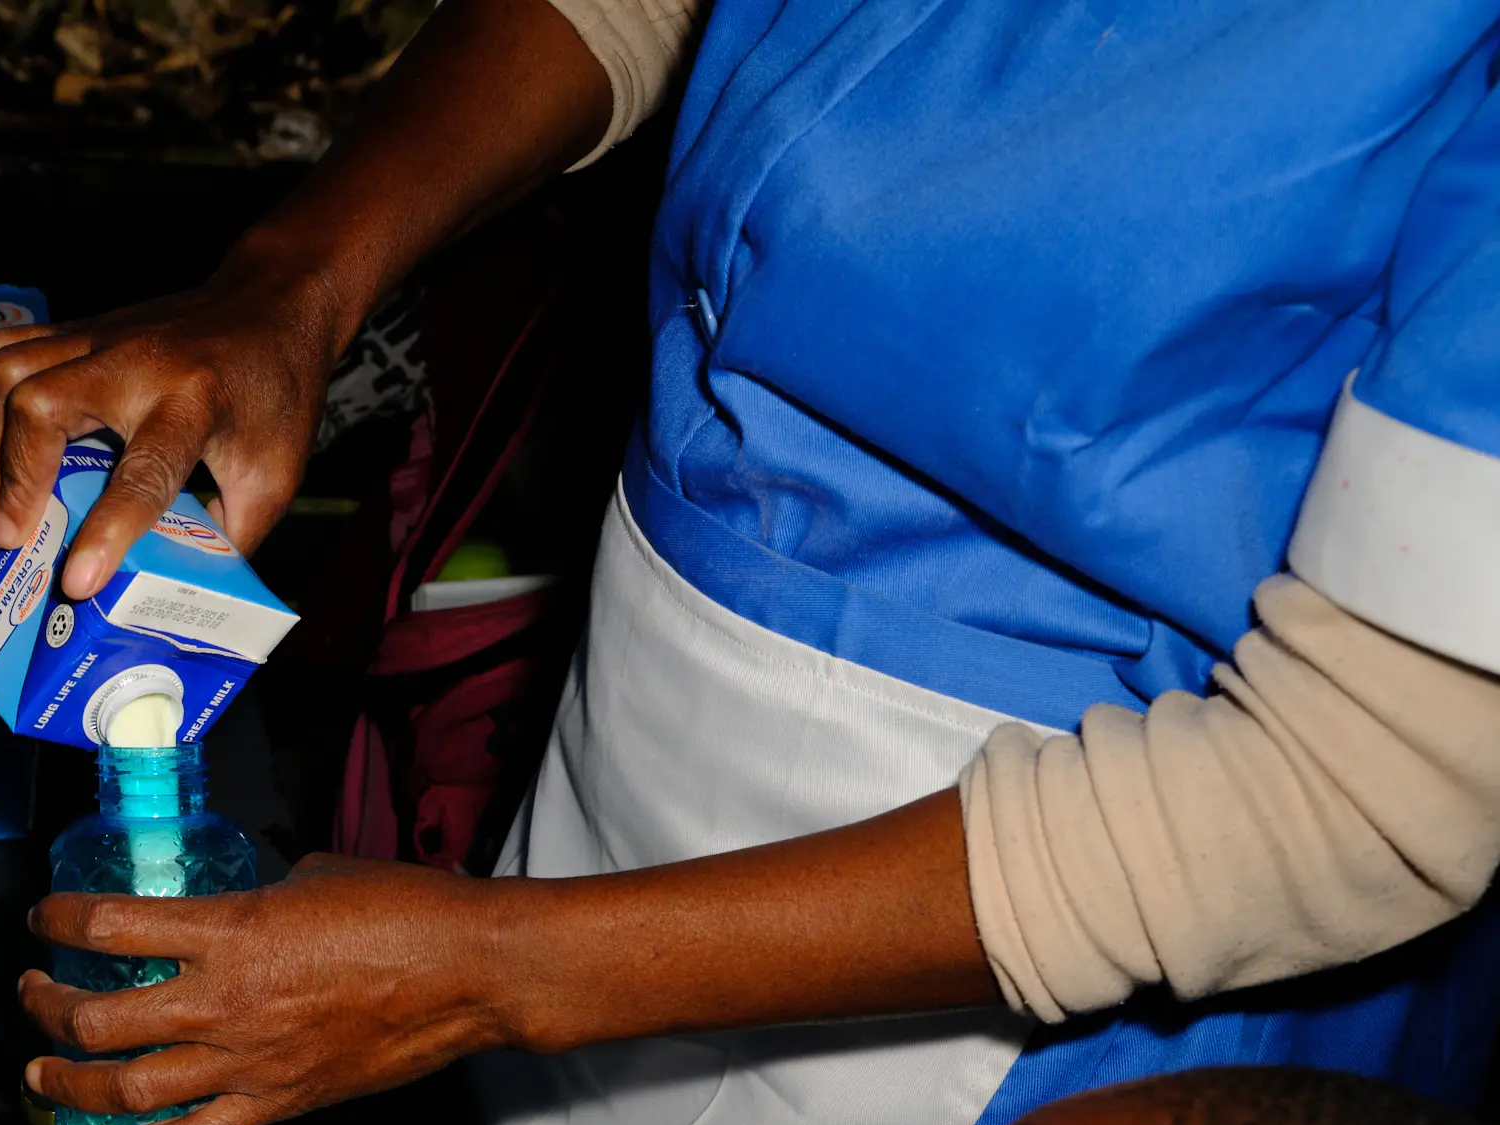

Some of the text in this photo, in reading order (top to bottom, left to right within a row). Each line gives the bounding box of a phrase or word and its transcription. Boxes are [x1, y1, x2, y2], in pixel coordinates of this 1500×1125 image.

[61, 455, 100, 466] MILK
[30, 519, 50, 558] FULL
[3, 569, 15, 587] UHT
[14, 548, 27, 569] LIFE
[1, 557, 32, 606] CREAM
[33, 700, 60, 731] LONG
[54, 677, 77, 703] LIFE
[71, 649, 98, 681] MILK
[181, 678, 235, 745] CREAM MILK
